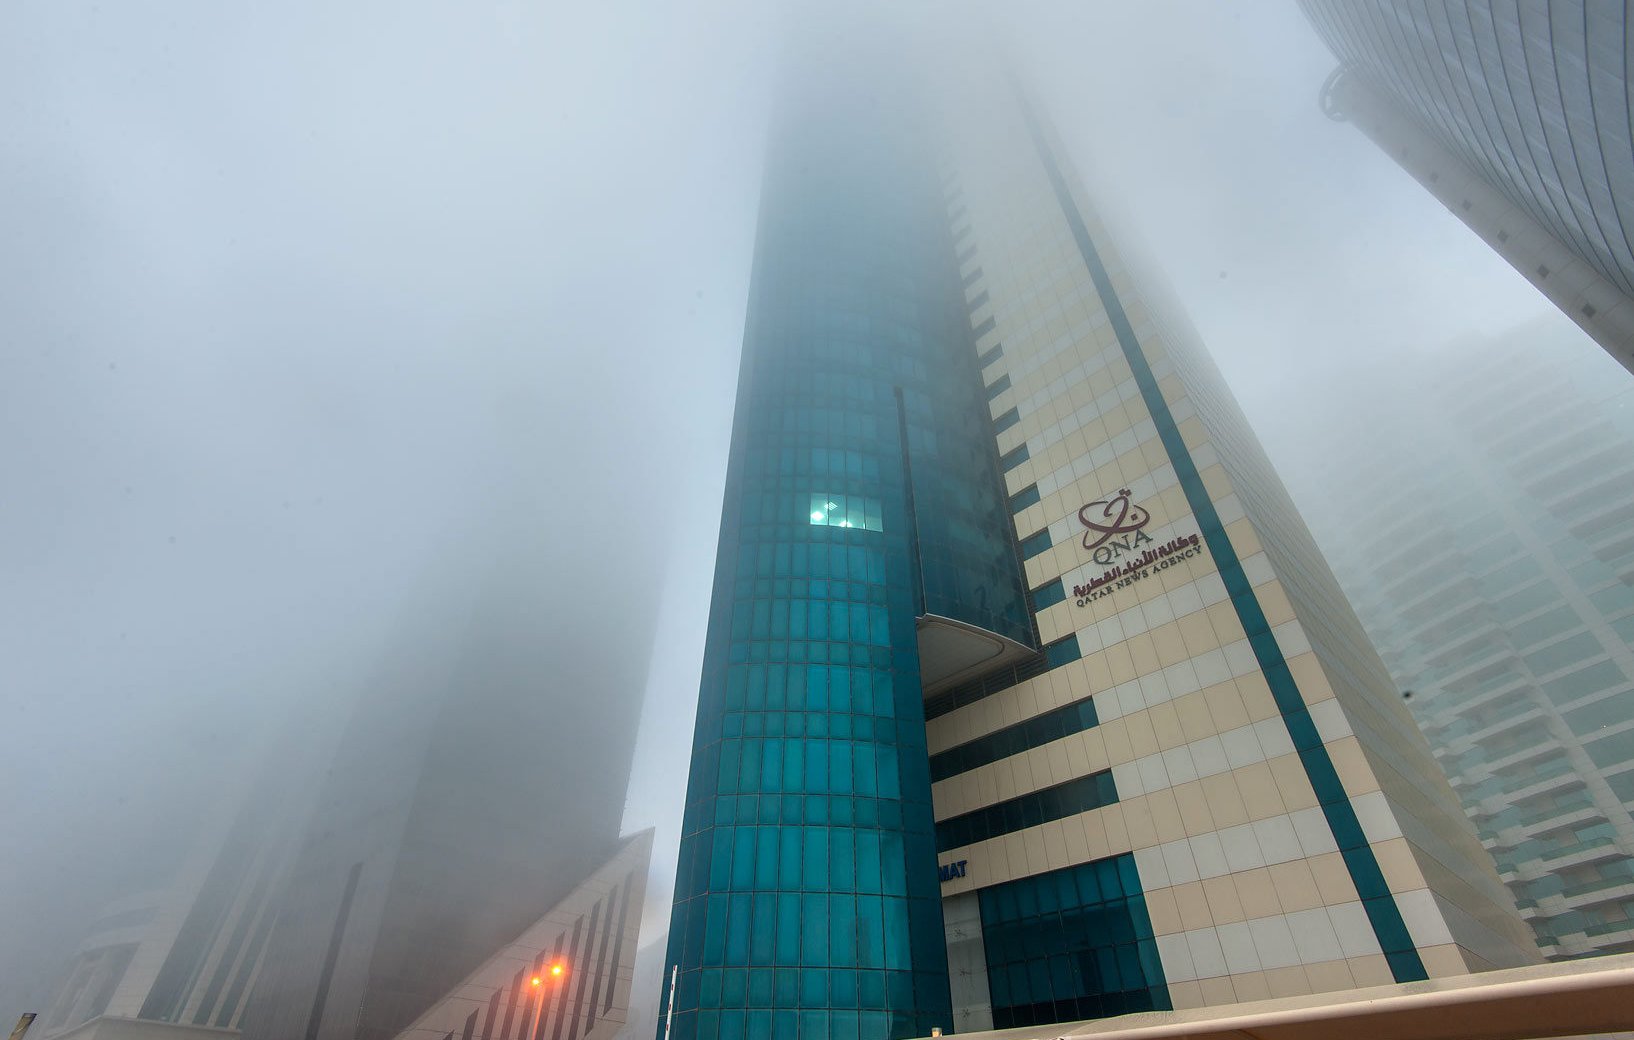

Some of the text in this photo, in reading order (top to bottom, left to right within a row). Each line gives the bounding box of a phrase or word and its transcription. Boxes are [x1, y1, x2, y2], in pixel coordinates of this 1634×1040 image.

[1093, 529, 1153, 565] QNA
[1158, 534, 1199, 558] وكالة
[1073, 566, 1121, 597] القطرية
[1076, 545, 1202, 608] QATAR NEWS AGENCY
